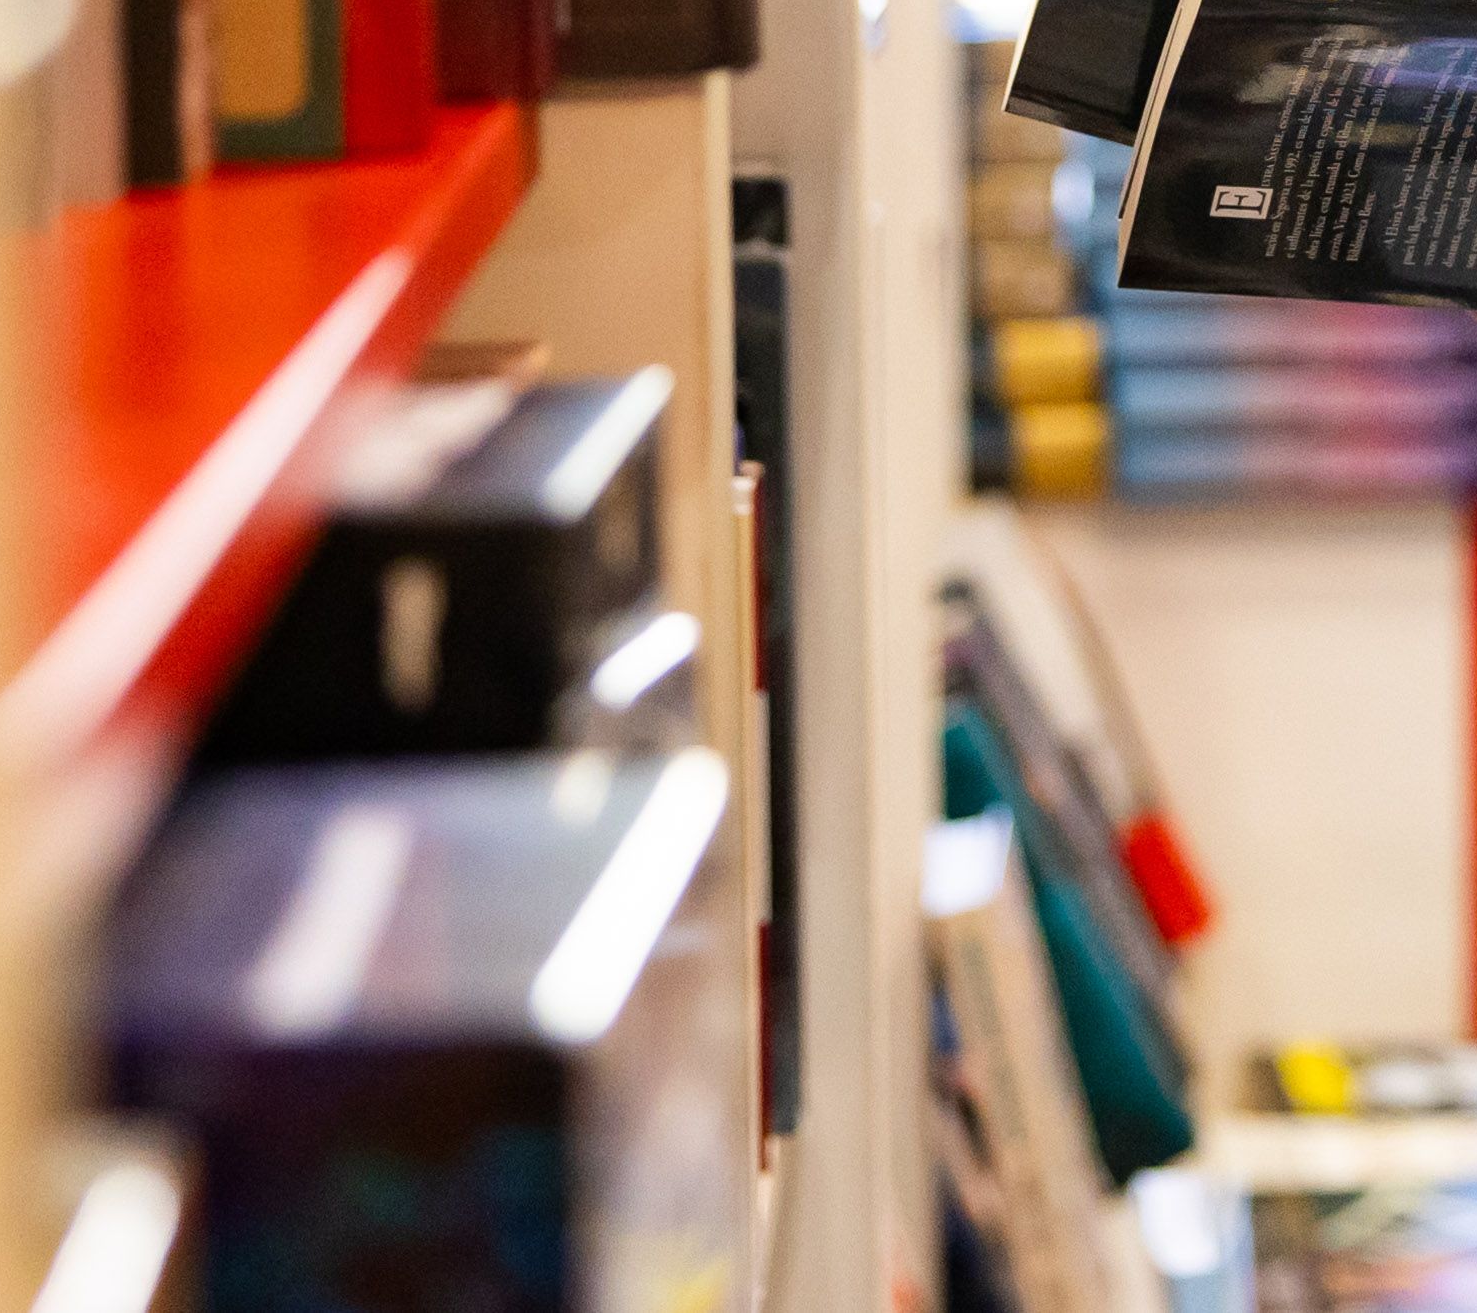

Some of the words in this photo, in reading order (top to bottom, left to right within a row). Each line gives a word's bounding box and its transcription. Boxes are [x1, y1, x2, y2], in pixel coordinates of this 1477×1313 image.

[1301, 103, 1316, 113] las
[1298, 114, 1312, 124] de
[1297, 125, 1309, 139] una
[1462, 124, 1475, 139] que
[1316, 138, 1326, 149] en
[1347, 152, 1365, 178] Como
[1371, 107, 1381, 116] en
[1432, 140, 1446, 150] ha
[1284, 150, 1301, 173] 1992,
[1308, 151, 1323, 177] poesía
[1335, 150, 1344, 160] en
[1427, 150, 1443, 179] porque
[1450, 140, 1468, 174] evidente
[1324, 162, 1341, 194] reunida
[1402, 164, 1417, 172] la
[1404, 173, 1414, 182] se
[1284, 176, 1294, 186] en
[1300, 179, 1315, 187] la
[1417, 180, 1434, 200] lejos
[1446, 176, 1457, 188] era
[1272, 187, 1291, 220] Segovia
[1297, 189, 1312, 201] de
[1320, 196, 1332, 213] está
[1393, 184, 1412, 209] Sastre
[1443, 191, 1453, 201] ya
[1272, 221, 1282, 232] en
[1309, 215, 1327, 237] lírica
[1384, 211, 1404, 236] Elvira
[1407, 201, 1427, 232] llegado
[1432, 203, 1448, 238] iniciales
[1441, 233, 1462, 267] distinta,
[1467, 176, 1477, 192] con
[1286, 203, 1308, 251] influyentes
[1345, 219, 1369, 261] Biblioteca
[1404, 233, 1419, 244] ha
[1305, 239, 1320, 259] obra
[1402, 245, 1416, 265] pués
[1424, 240, 1438, 266] versos
[1466, 253, 1477, 268] son
